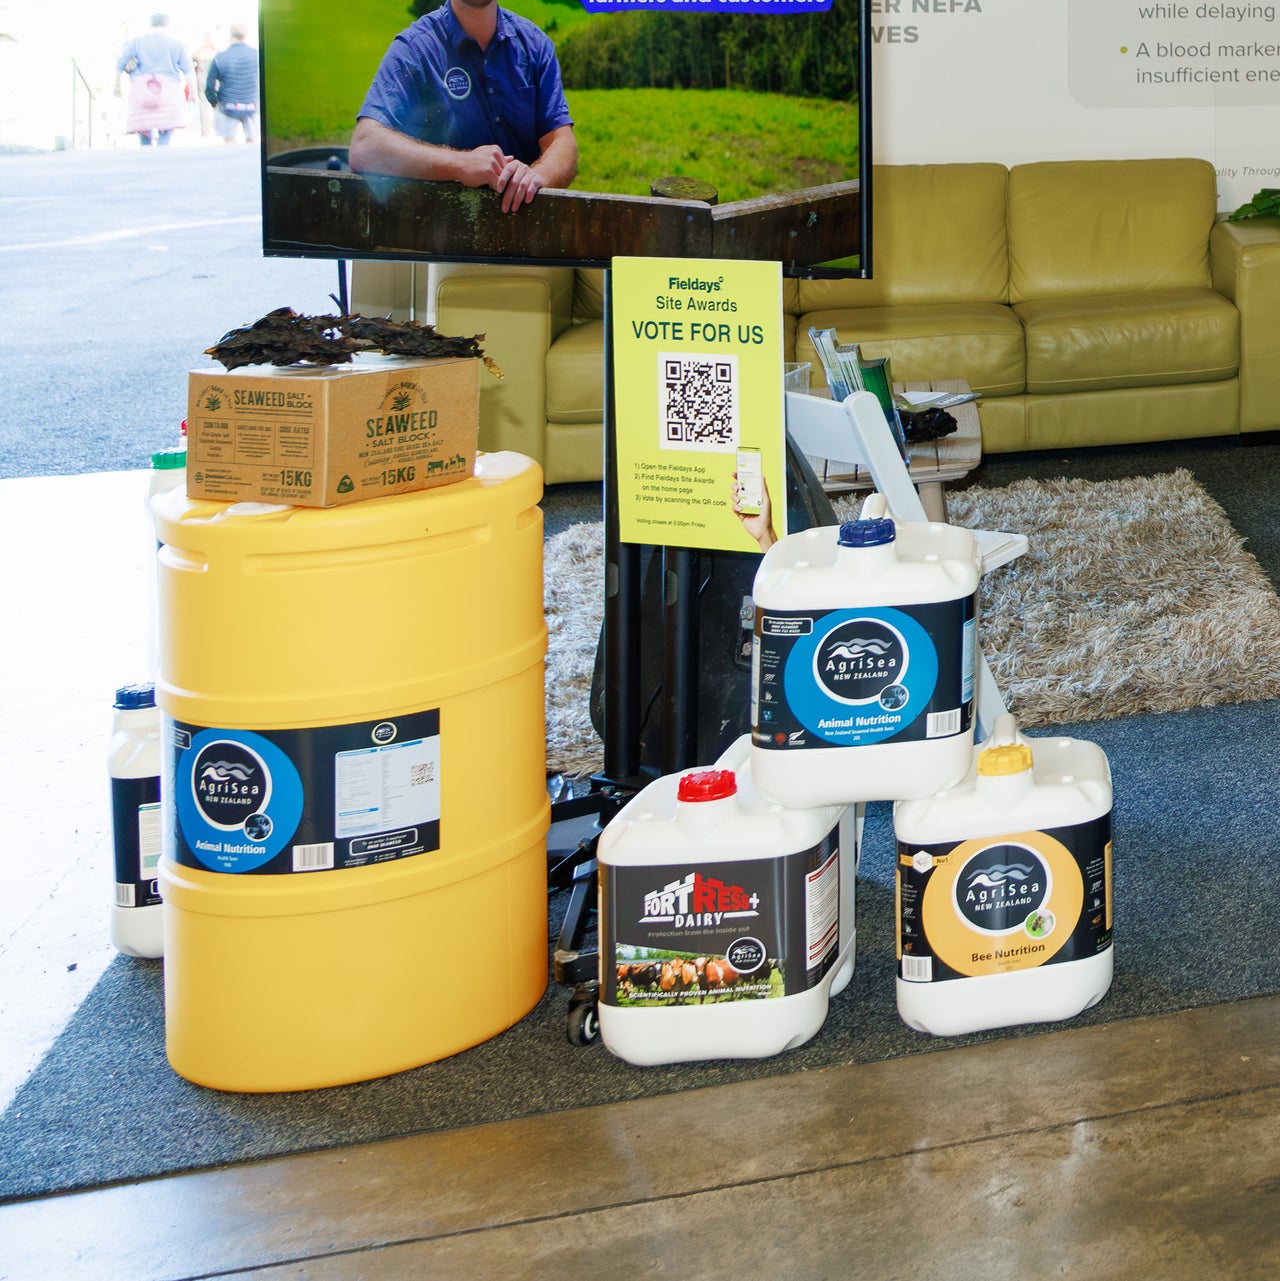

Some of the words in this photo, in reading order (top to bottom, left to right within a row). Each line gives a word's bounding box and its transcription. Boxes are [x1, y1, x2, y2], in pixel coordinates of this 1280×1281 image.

[669, 277, 721, 293] Fieldays
[656, 296, 682, 310] Site
[687, 297, 738, 312] Awards
[632, 321, 684, 341] VOTE
[691, 322, 731, 342] FOR
[738, 325, 764, 344] US
[234, 389, 284, 408] SEAWEED
[287, 400, 313, 408] BLOCK
[366, 410, 438, 438] SEAWEED
[372, 436, 394, 448] SALT
[398, 432, 430, 443] BLOCK
[280, 470, 312, 487] 15KG
[381, 466, 415, 486] 15KG
[825, 657, 896, 671] AgriSea
[833, 671, 851, 681] NEW
[853, 669, 888, 680] ZEALAND
[817, 715, 853, 729] Animal
[856, 713, 901, 727] Nutrition
[200, 779, 259, 796] AgriSea
[196, 839, 221, 853] Animal
[224, 844, 266, 854] Nutrition
[966, 882, 1039, 902] AgriSea
[975, 903, 993, 911] NEW
[996, 897, 1032, 909] ZEALAND
[674, 913, 722, 927] DAIRY
[971, 953, 993, 962] Bee
[995, 944, 1045, 959] Nutrition
